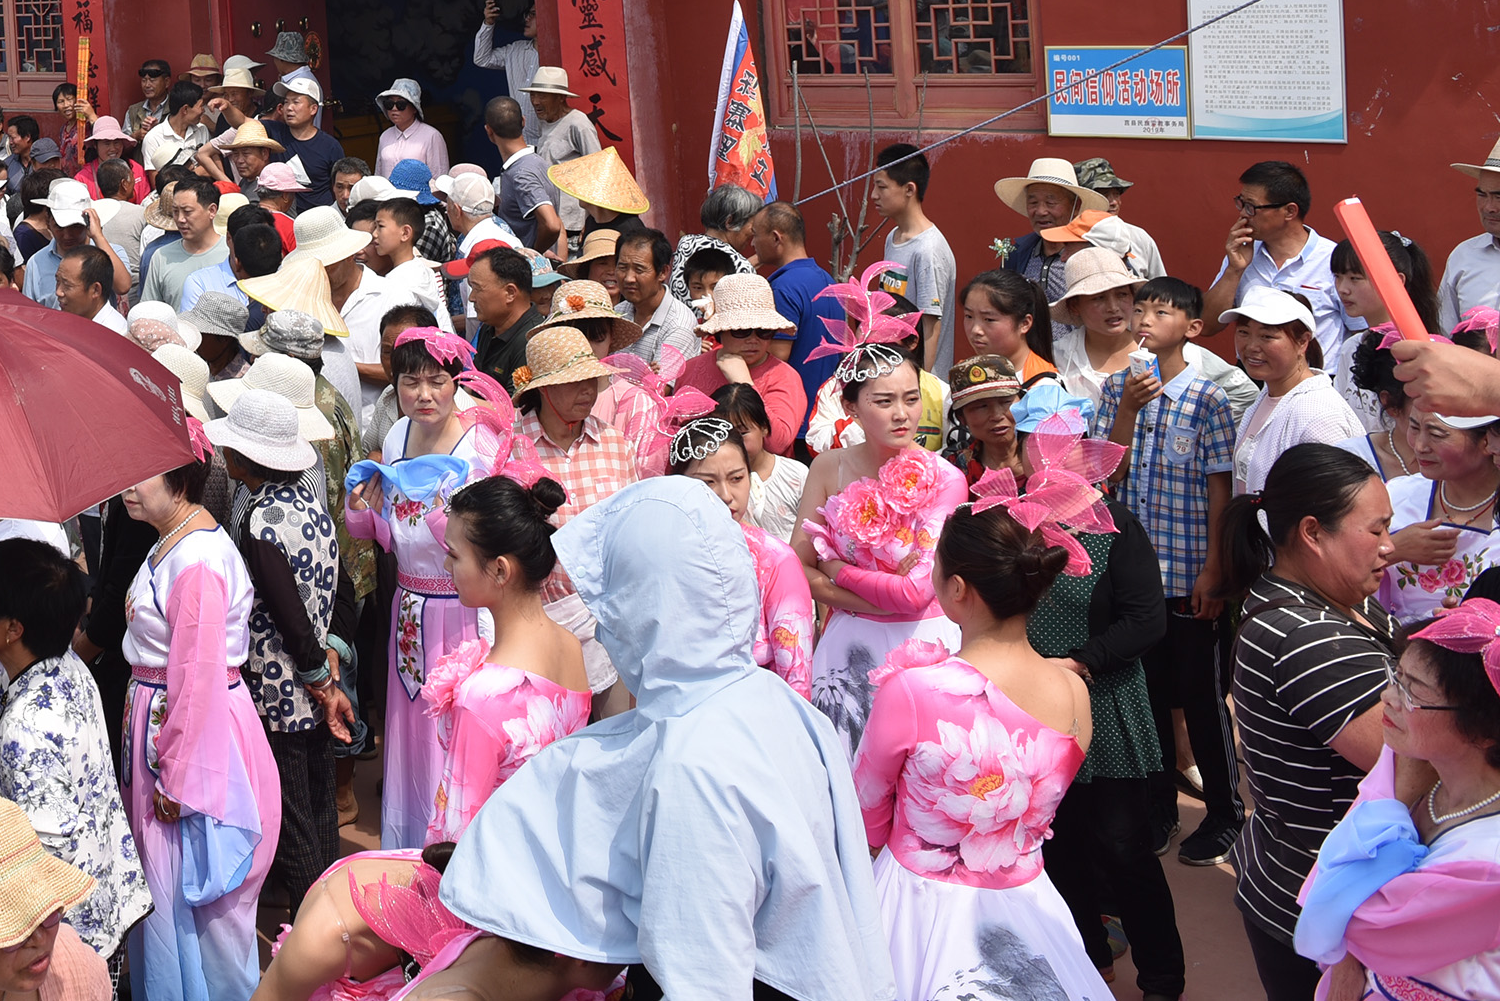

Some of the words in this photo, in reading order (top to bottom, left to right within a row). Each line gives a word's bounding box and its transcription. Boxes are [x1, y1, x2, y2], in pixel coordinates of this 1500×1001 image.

[1054, 68, 1180, 107] 民间信仰活动场所
